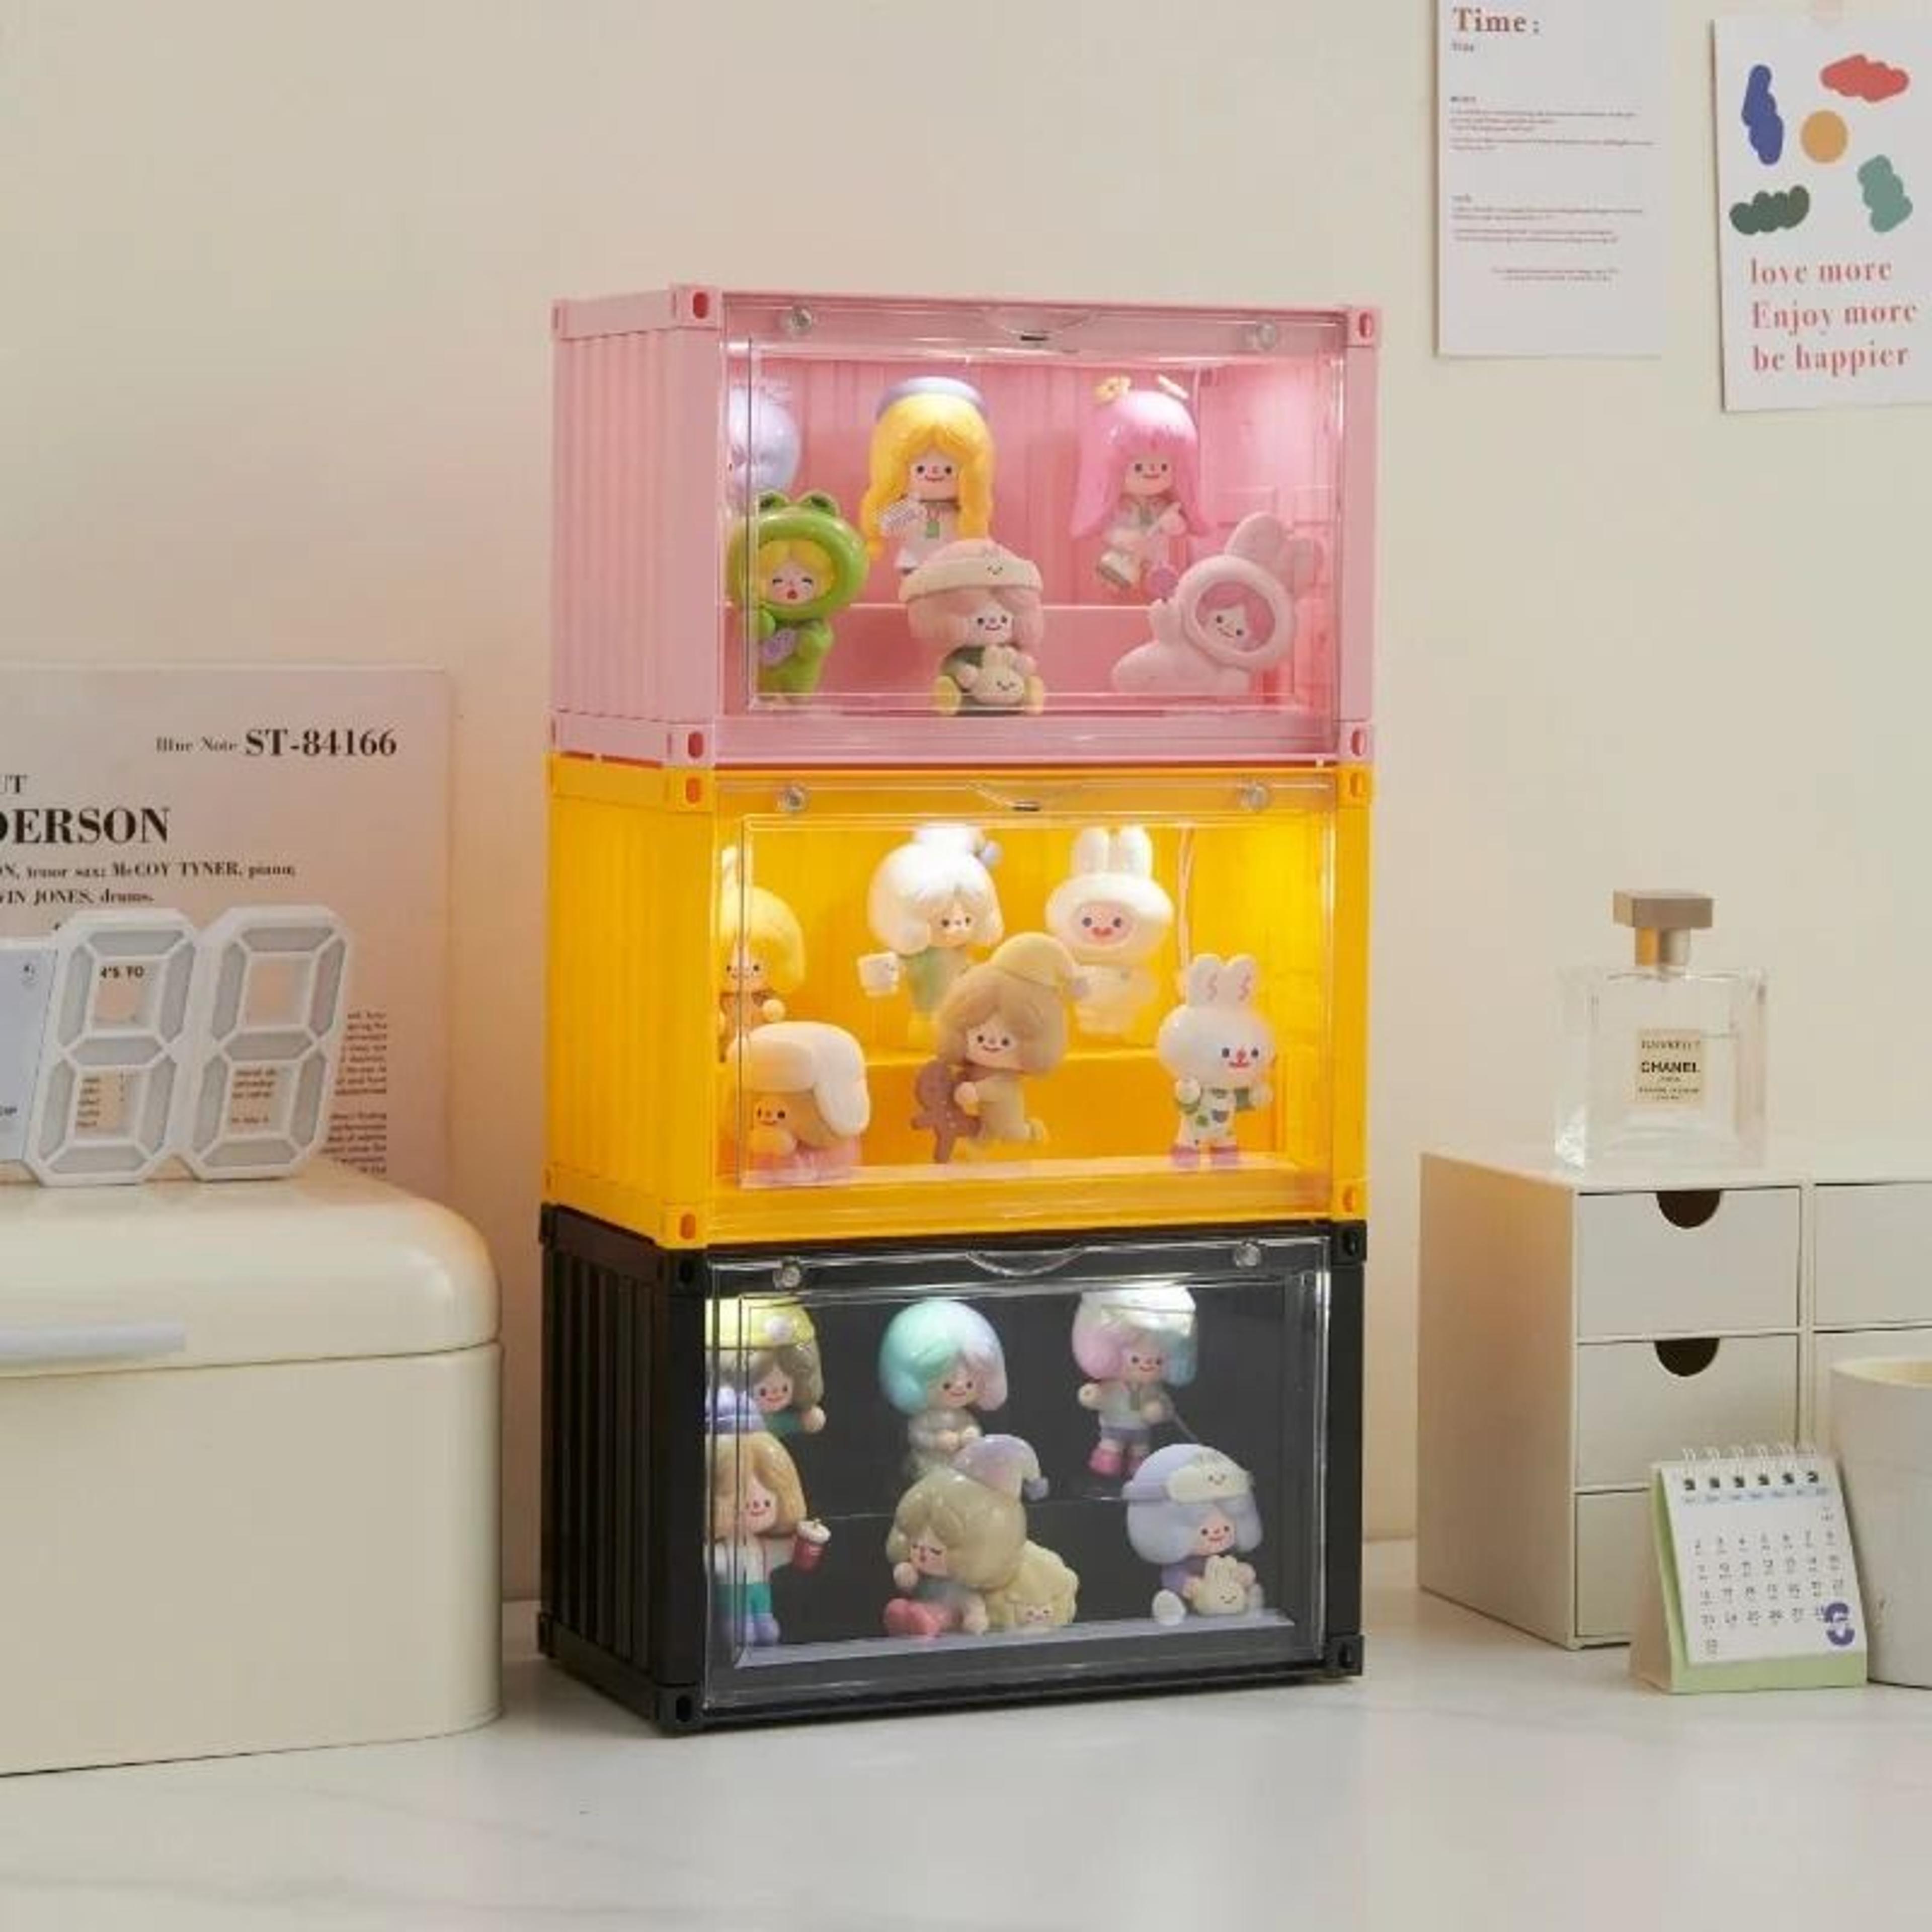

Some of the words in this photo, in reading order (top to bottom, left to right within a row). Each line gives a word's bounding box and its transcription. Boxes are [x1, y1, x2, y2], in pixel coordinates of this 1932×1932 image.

[1751, 257, 1808, 284] love
[1819, 262, 1892, 281] more
[1752, 299, 1834, 337] Enjoy
[1844, 304, 1917, 325] more
[1752, 344, 1786, 371] be
[1796, 340, 1909, 377] happier
[155, 737, 193, 752] Blue
[201, 736, 238, 752] Note
[245, 728, 397, 756] ST-84166
[0, 807, 171, 844] ERSON
[0, 863, 20, 879] N,
[113, 861, 169, 877] McCOY
[1641, 1061, 1701, 1073] CHANEL
